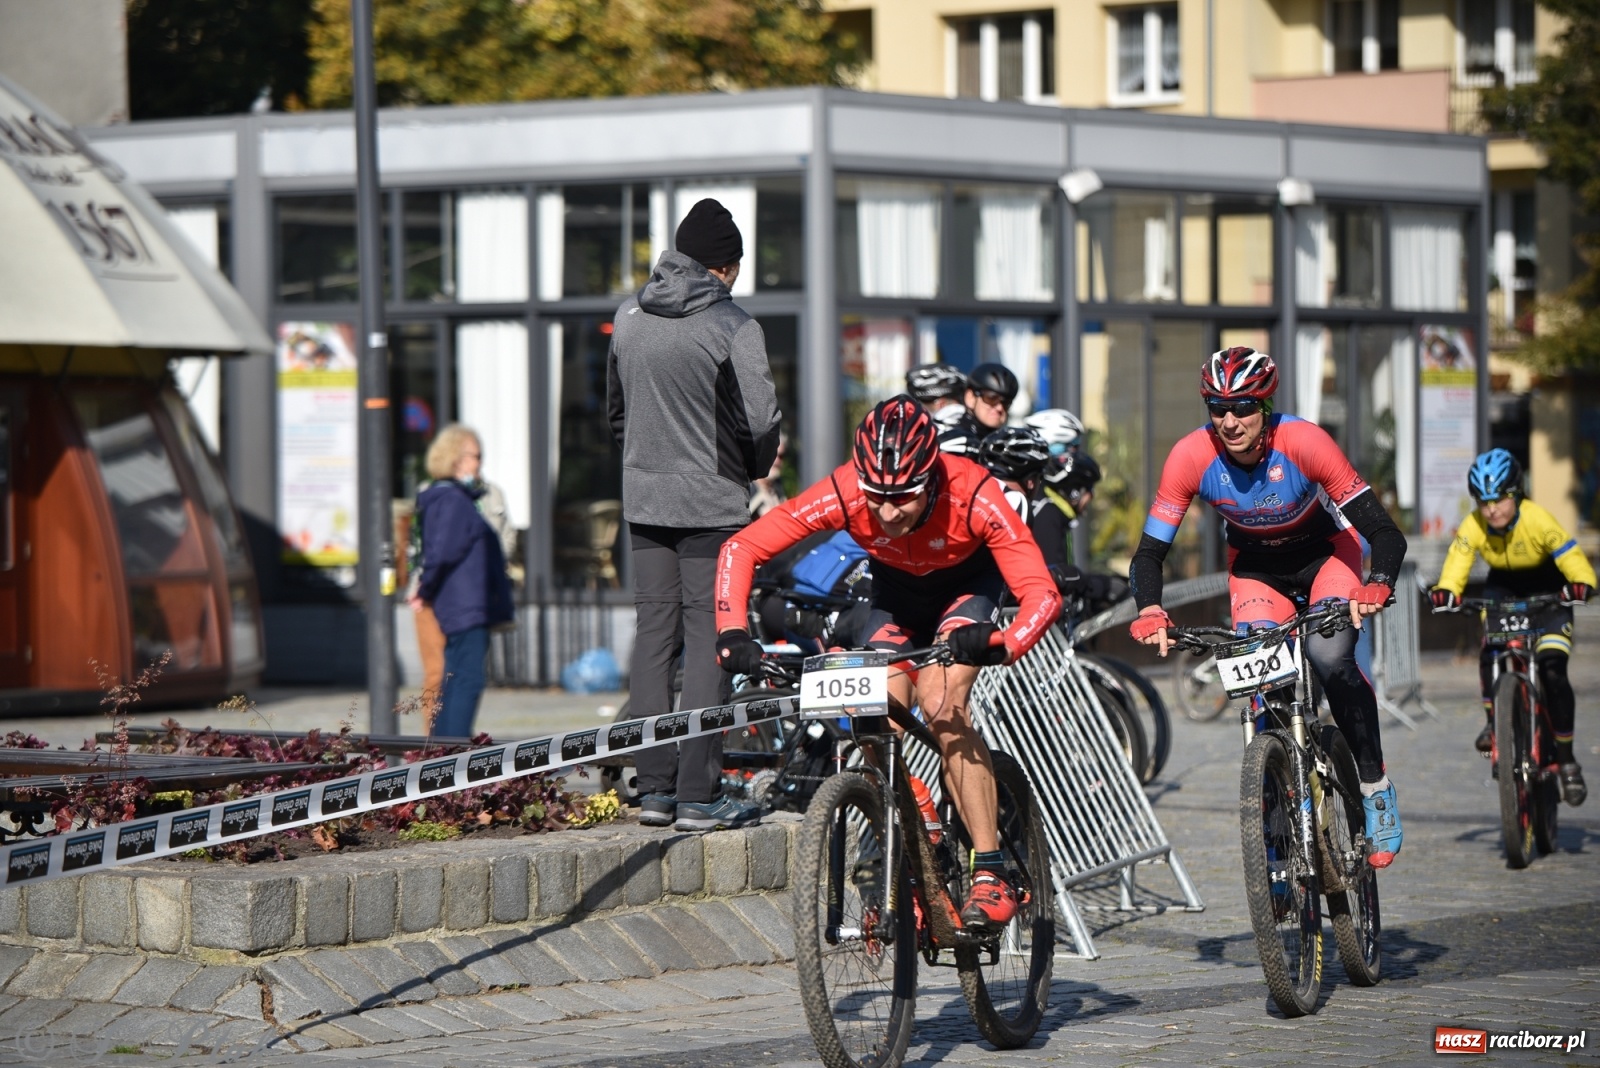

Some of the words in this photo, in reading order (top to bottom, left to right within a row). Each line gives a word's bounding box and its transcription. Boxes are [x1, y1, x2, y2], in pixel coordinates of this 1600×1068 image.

[721, 568, 731, 598] LIFTING
[1232, 654, 1282, 682] 1120
[816, 676, 872, 699] 1058
[656, 717, 675, 729] atelier
[675, 714, 688, 725] bike
[610, 726, 628, 739] atelier
[628, 723, 641, 735] bike
[563, 736, 581, 749] atelier
[582, 733, 595, 744] bike
[516, 746, 534, 759] atelier
[535, 743, 548, 754] bike
[468, 756, 488, 770] atelier
[488, 754, 501, 765] bike
[420, 766, 440, 780] atelier
[441, 764, 454, 776] bike
[372, 777, 392, 791] atelier
[392, 774, 405, 786] bike
[323, 788, 343, 802] atelier
[343, 785, 357, 797] bike
[273, 798, 294, 813] atelier
[294, 796, 308, 808] bike
[223, 809, 244, 824] atelier
[244, 807, 258, 819] bike
[172, 819, 193, 835] atelier
[193, 817, 207, 830] bike
[119, 830, 140, 846] atelier
[140, 827, 155, 841] bike
[65, 841, 87, 858] atelier
[87, 838, 102, 852] bike
[10, 852, 33, 869] atelier
[32, 850, 48, 864] bike
